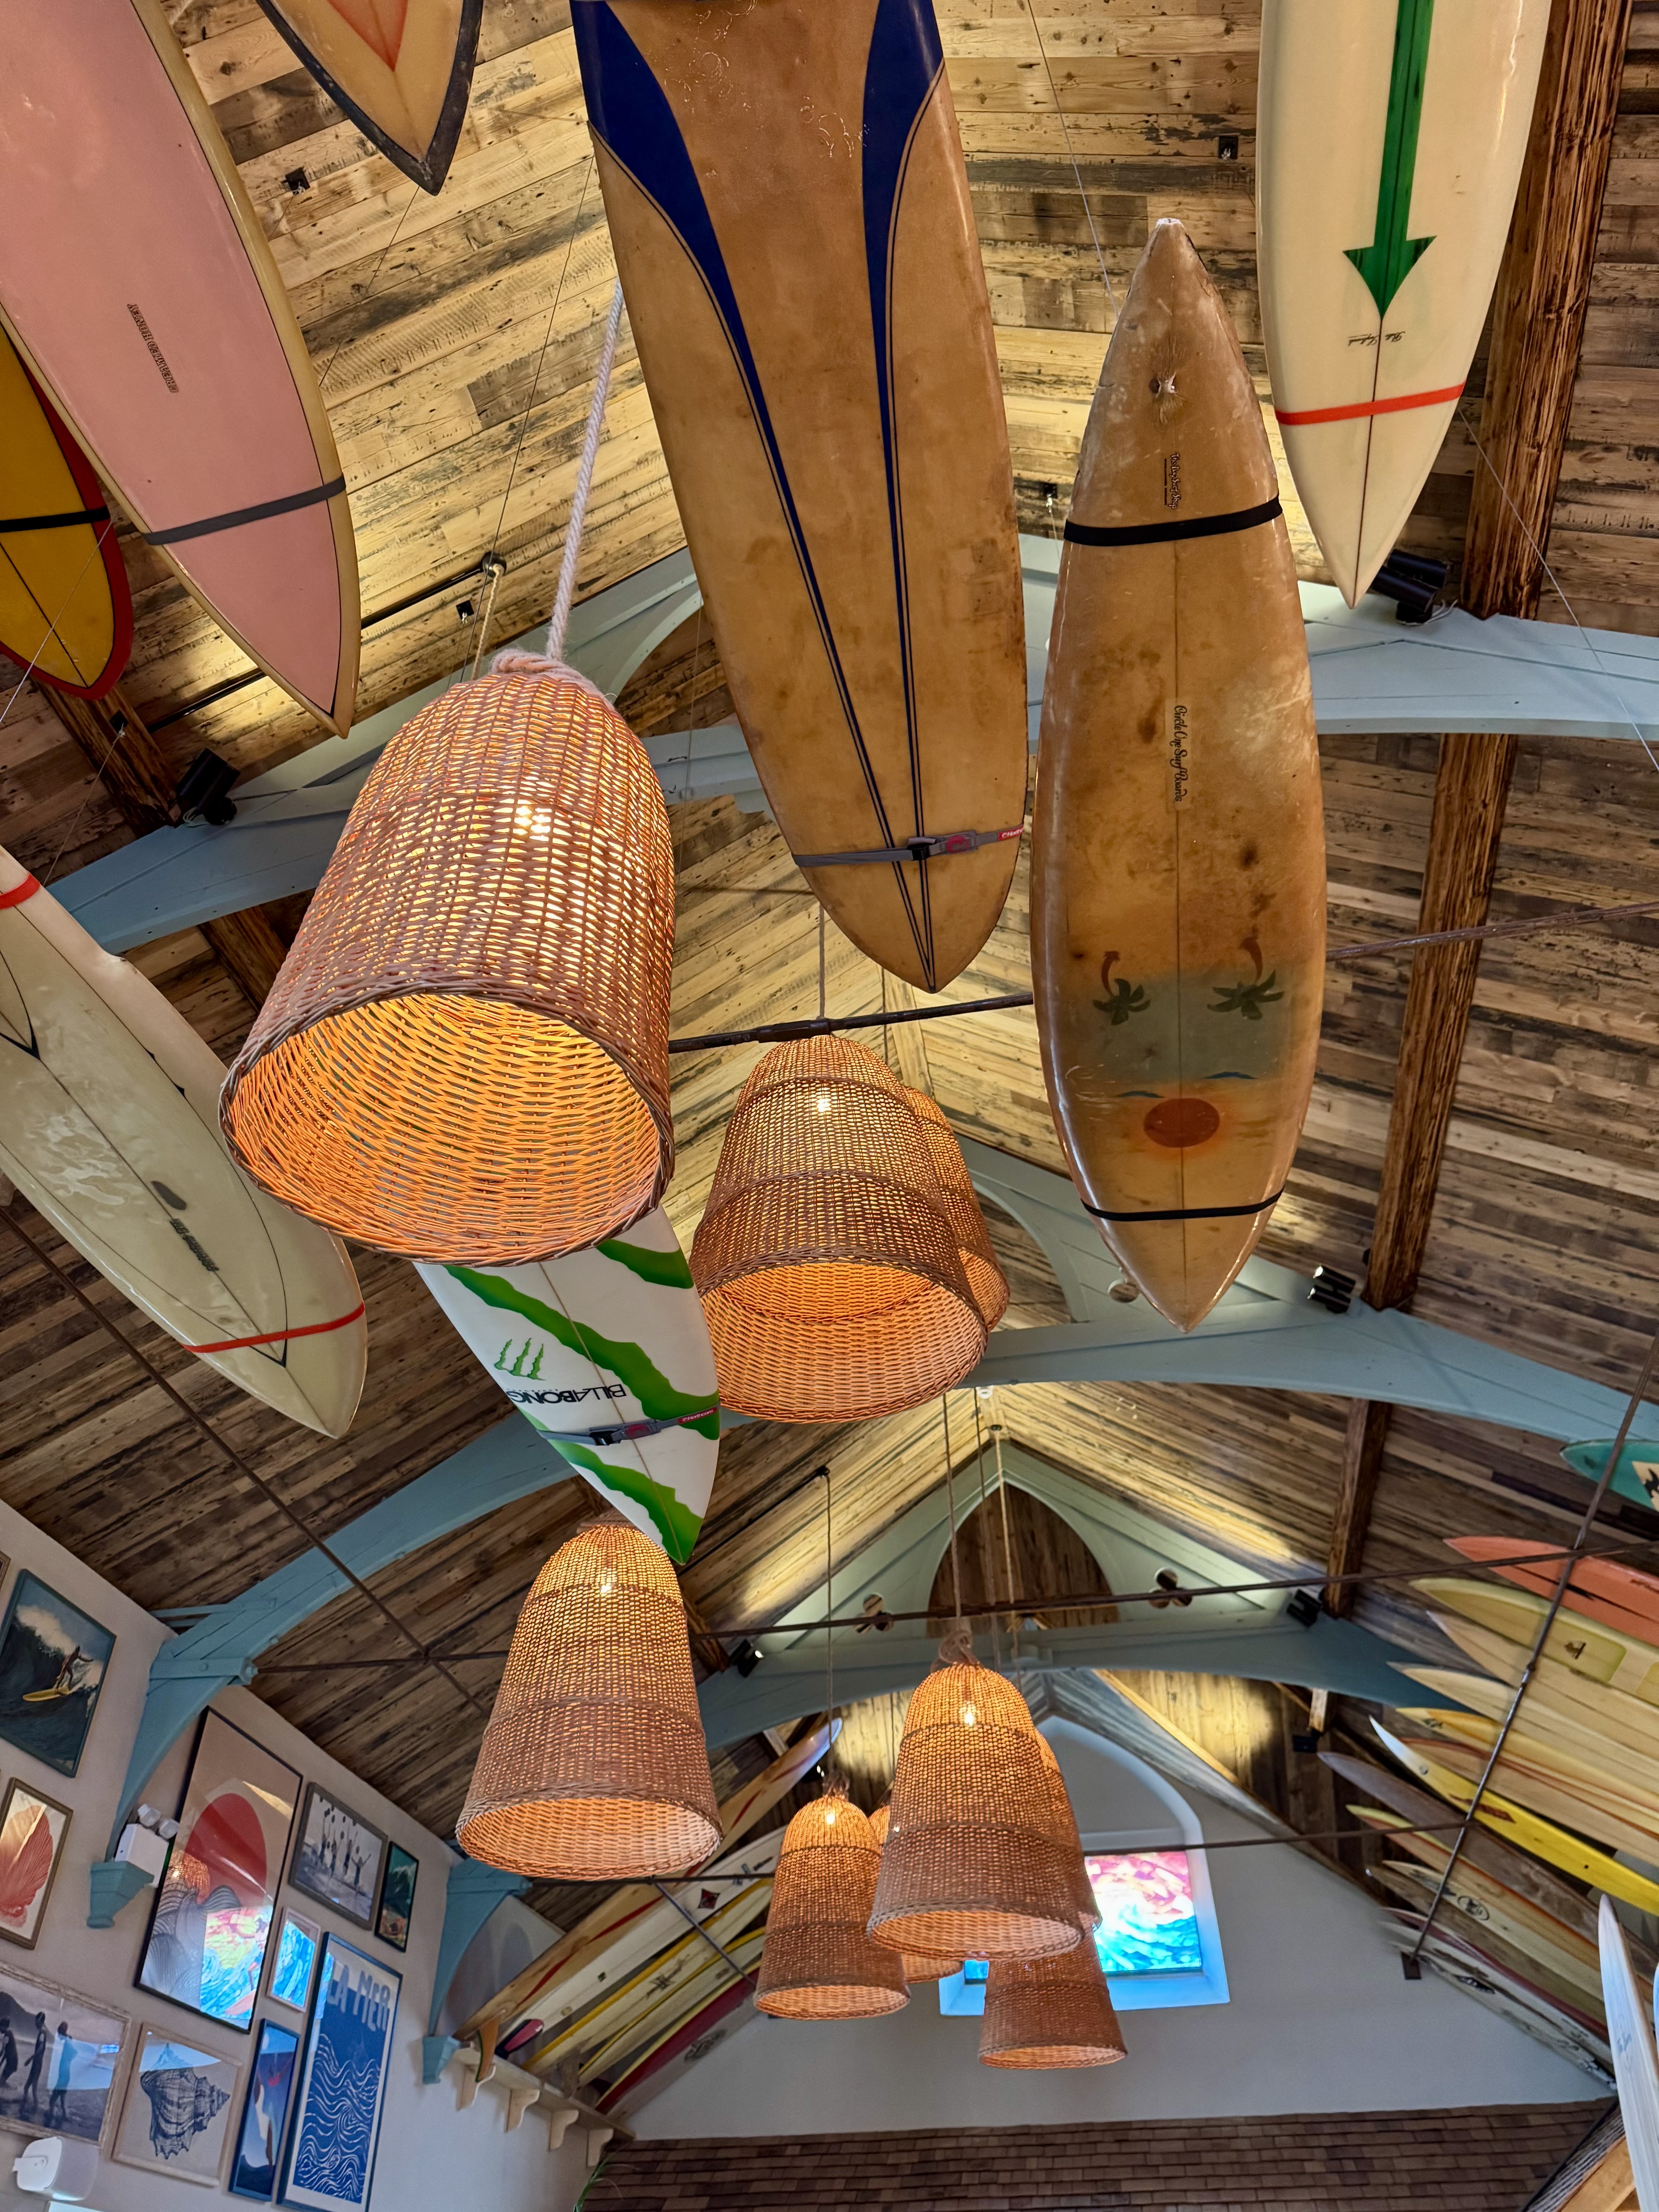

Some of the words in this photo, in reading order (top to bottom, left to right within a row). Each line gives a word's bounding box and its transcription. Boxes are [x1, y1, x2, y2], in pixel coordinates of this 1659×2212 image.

[127, 304, 154, 341] HONEY
[147, 341, 179, 393] CREAMED
[1170, 478, 1181, 493] Surf
[1167, 493, 1182, 509] Shop
[1174, 705, 1187, 731] Circle
[1169, 730, 1188, 748] One
[506, 1384, 627, 1404] BILLABONG
[327, 1960, 349, 2013] LA
